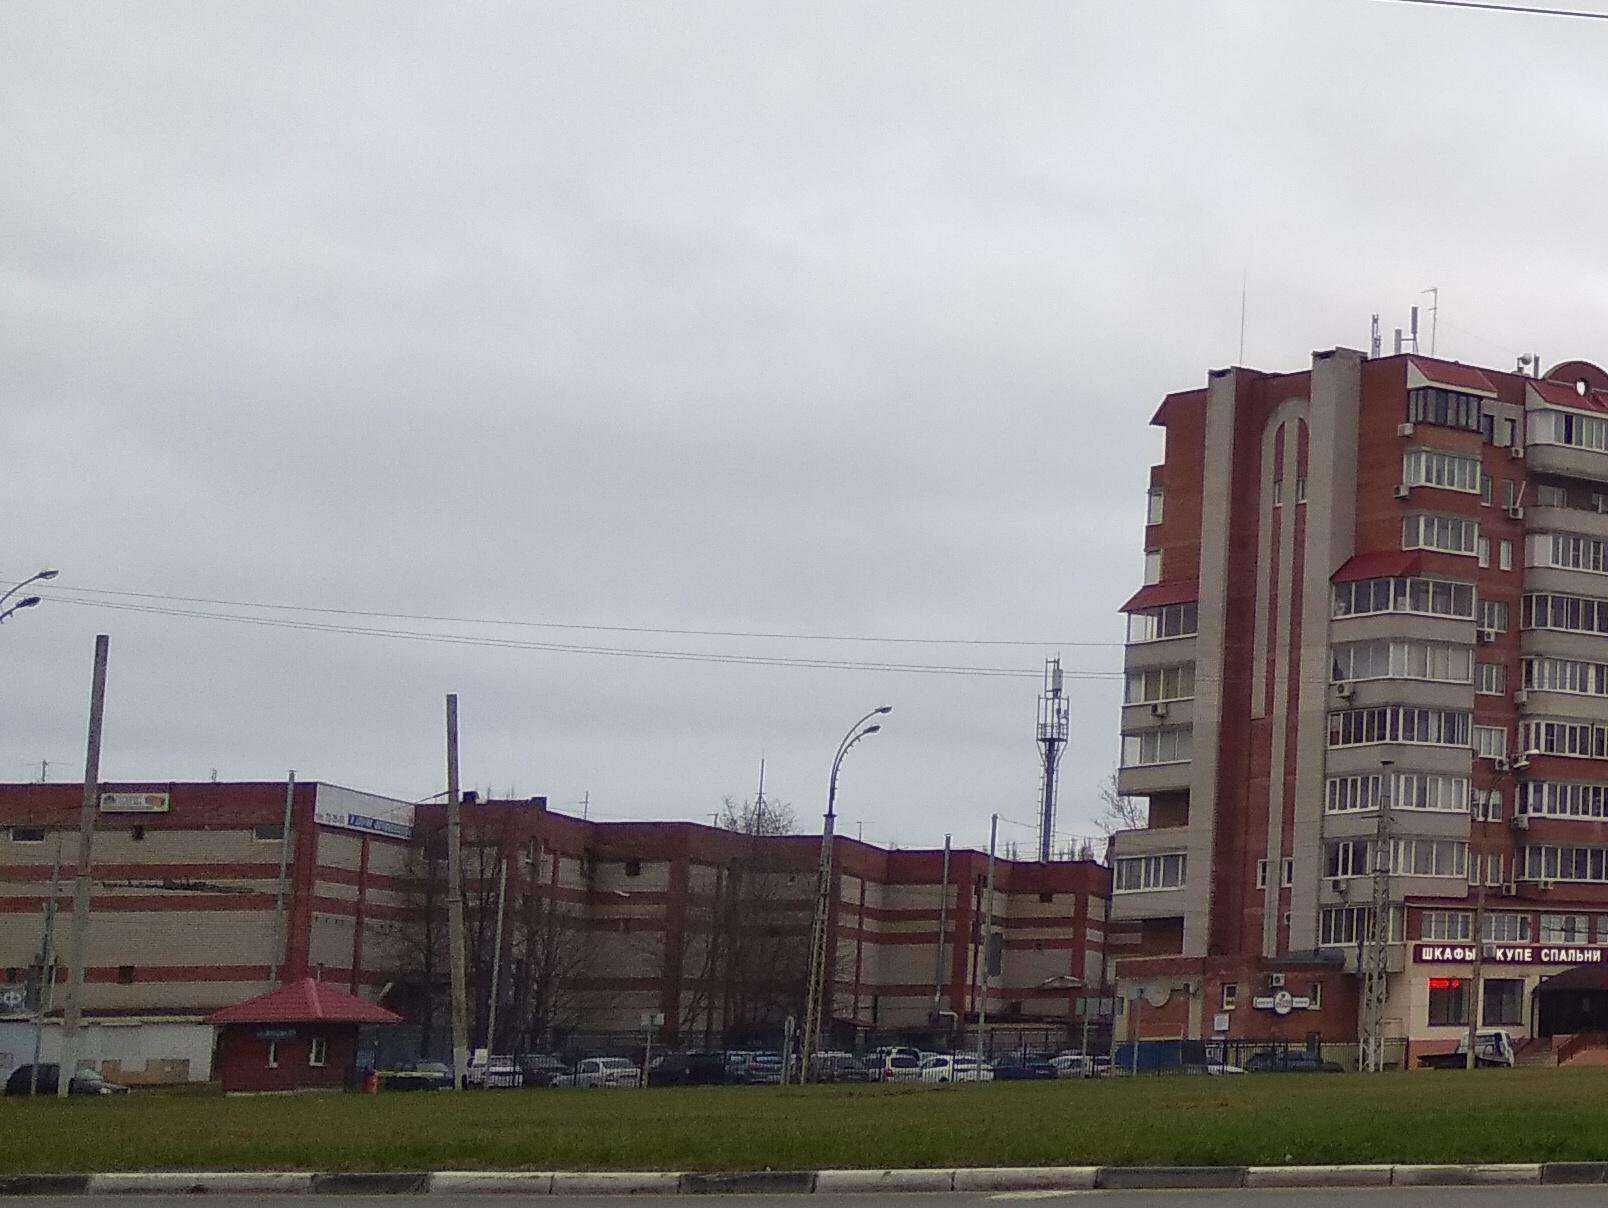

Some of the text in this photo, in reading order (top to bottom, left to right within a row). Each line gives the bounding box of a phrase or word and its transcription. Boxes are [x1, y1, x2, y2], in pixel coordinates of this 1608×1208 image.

[1422, 947, 1476, 960] ШКАФЫ
[1496, 949, 1533, 961] КУПЕ
[1541, 949, 1601, 962] СПАЛЬНИ
